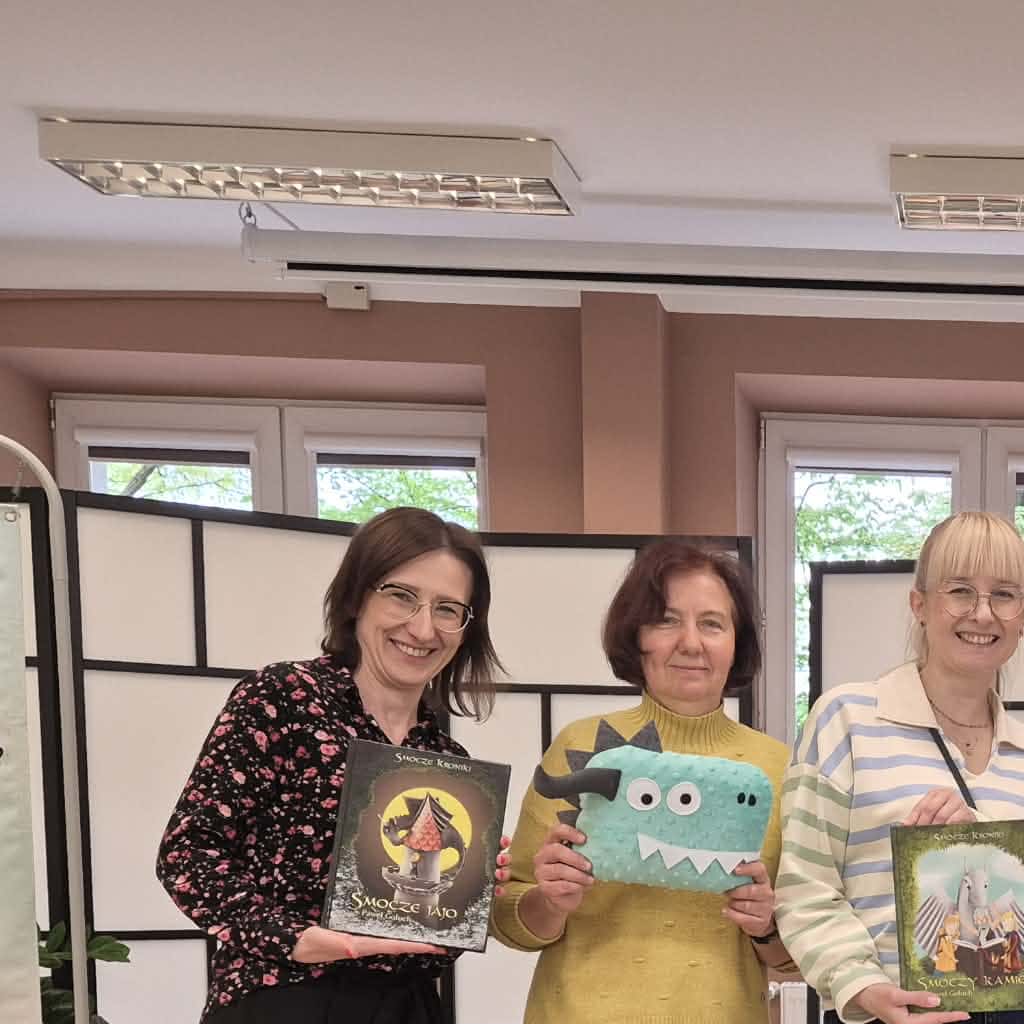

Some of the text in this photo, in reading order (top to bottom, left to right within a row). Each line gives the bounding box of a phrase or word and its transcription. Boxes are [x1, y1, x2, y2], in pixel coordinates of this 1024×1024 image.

[351, 892, 457, 920] SMOCZE JAJO
[918, 976, 977, 992] SMOCZY
